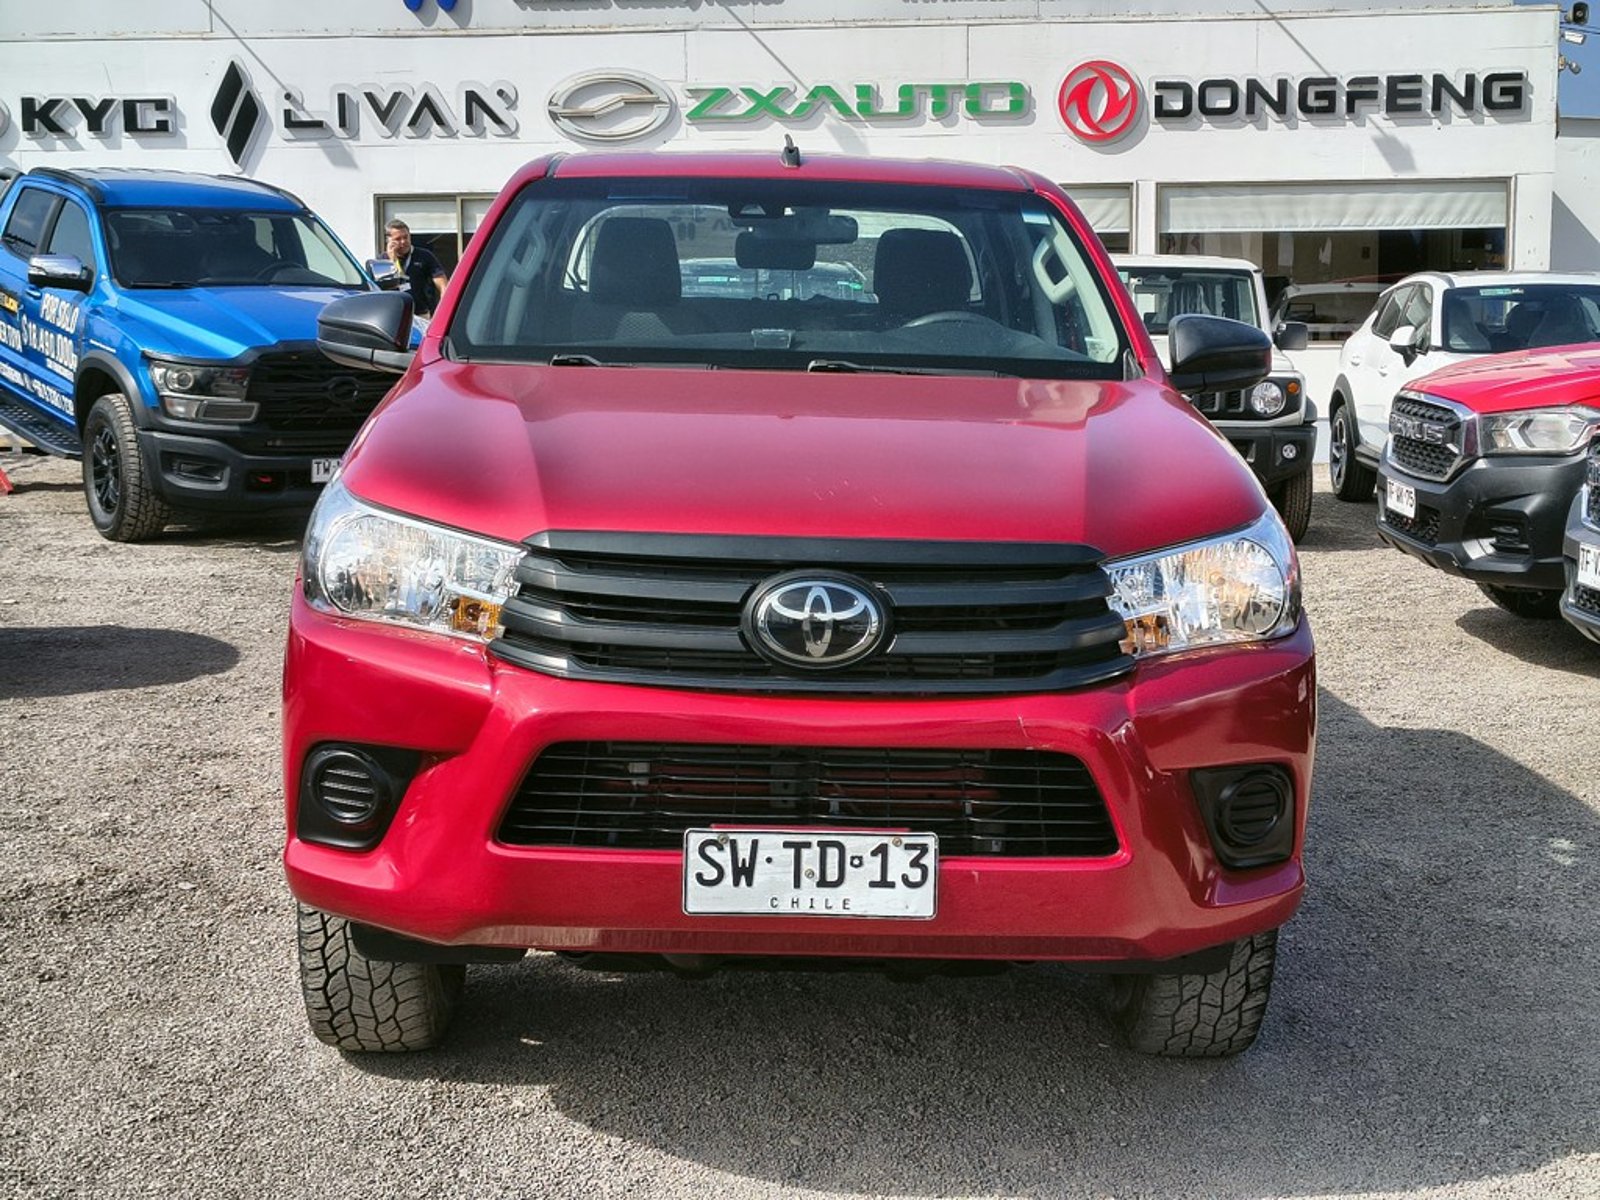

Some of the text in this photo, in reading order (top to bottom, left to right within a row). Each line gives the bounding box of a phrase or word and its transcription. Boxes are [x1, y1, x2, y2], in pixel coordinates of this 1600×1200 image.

[283, 88, 509, 129] LIVAN
[685, 82, 1025, 120] ZXAUTO
[1154, 72, 1524, 118] DONGFENG
[21, 97, 170, 132] KYC
[770, 897, 851, 910] CHILE
